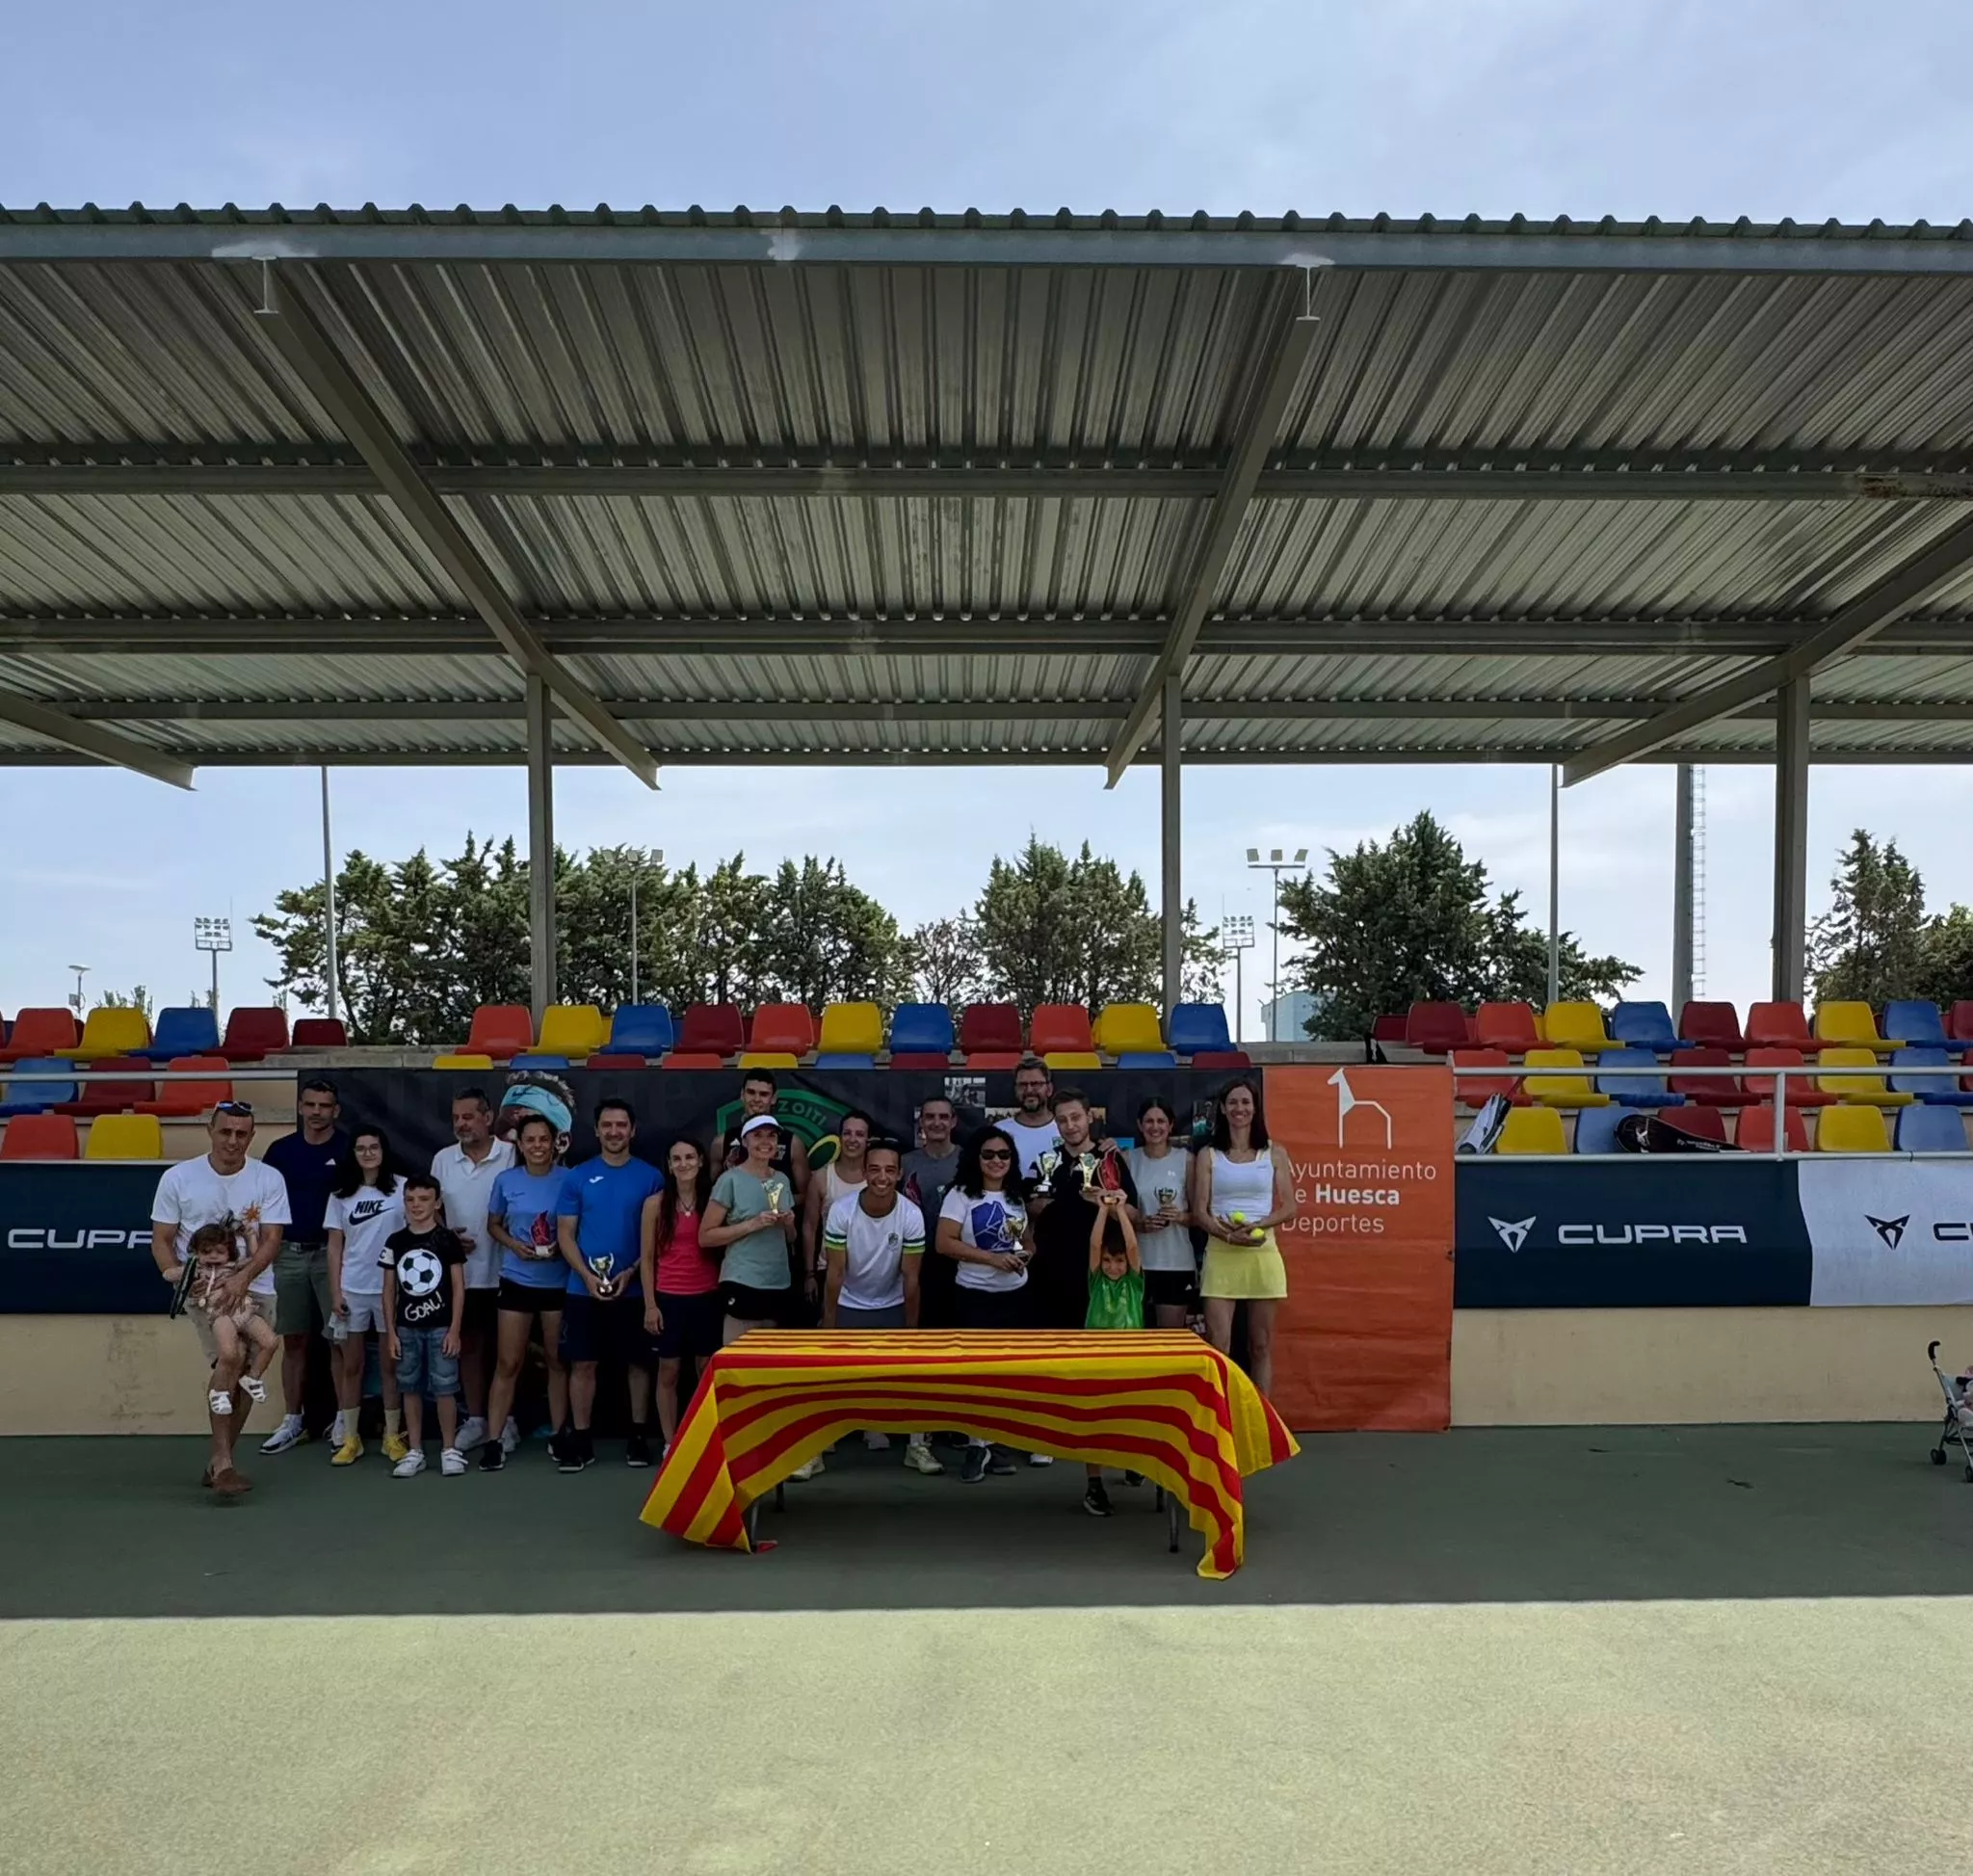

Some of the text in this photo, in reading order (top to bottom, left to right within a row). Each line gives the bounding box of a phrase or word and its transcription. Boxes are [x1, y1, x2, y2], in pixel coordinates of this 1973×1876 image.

[1295, 1183, 1400, 1204] e Huesca
[355, 1200, 385, 1213] NIKE
[1558, 1225, 1748, 1244] CUPRA
[405, 1291, 445, 1321] GOAL!
